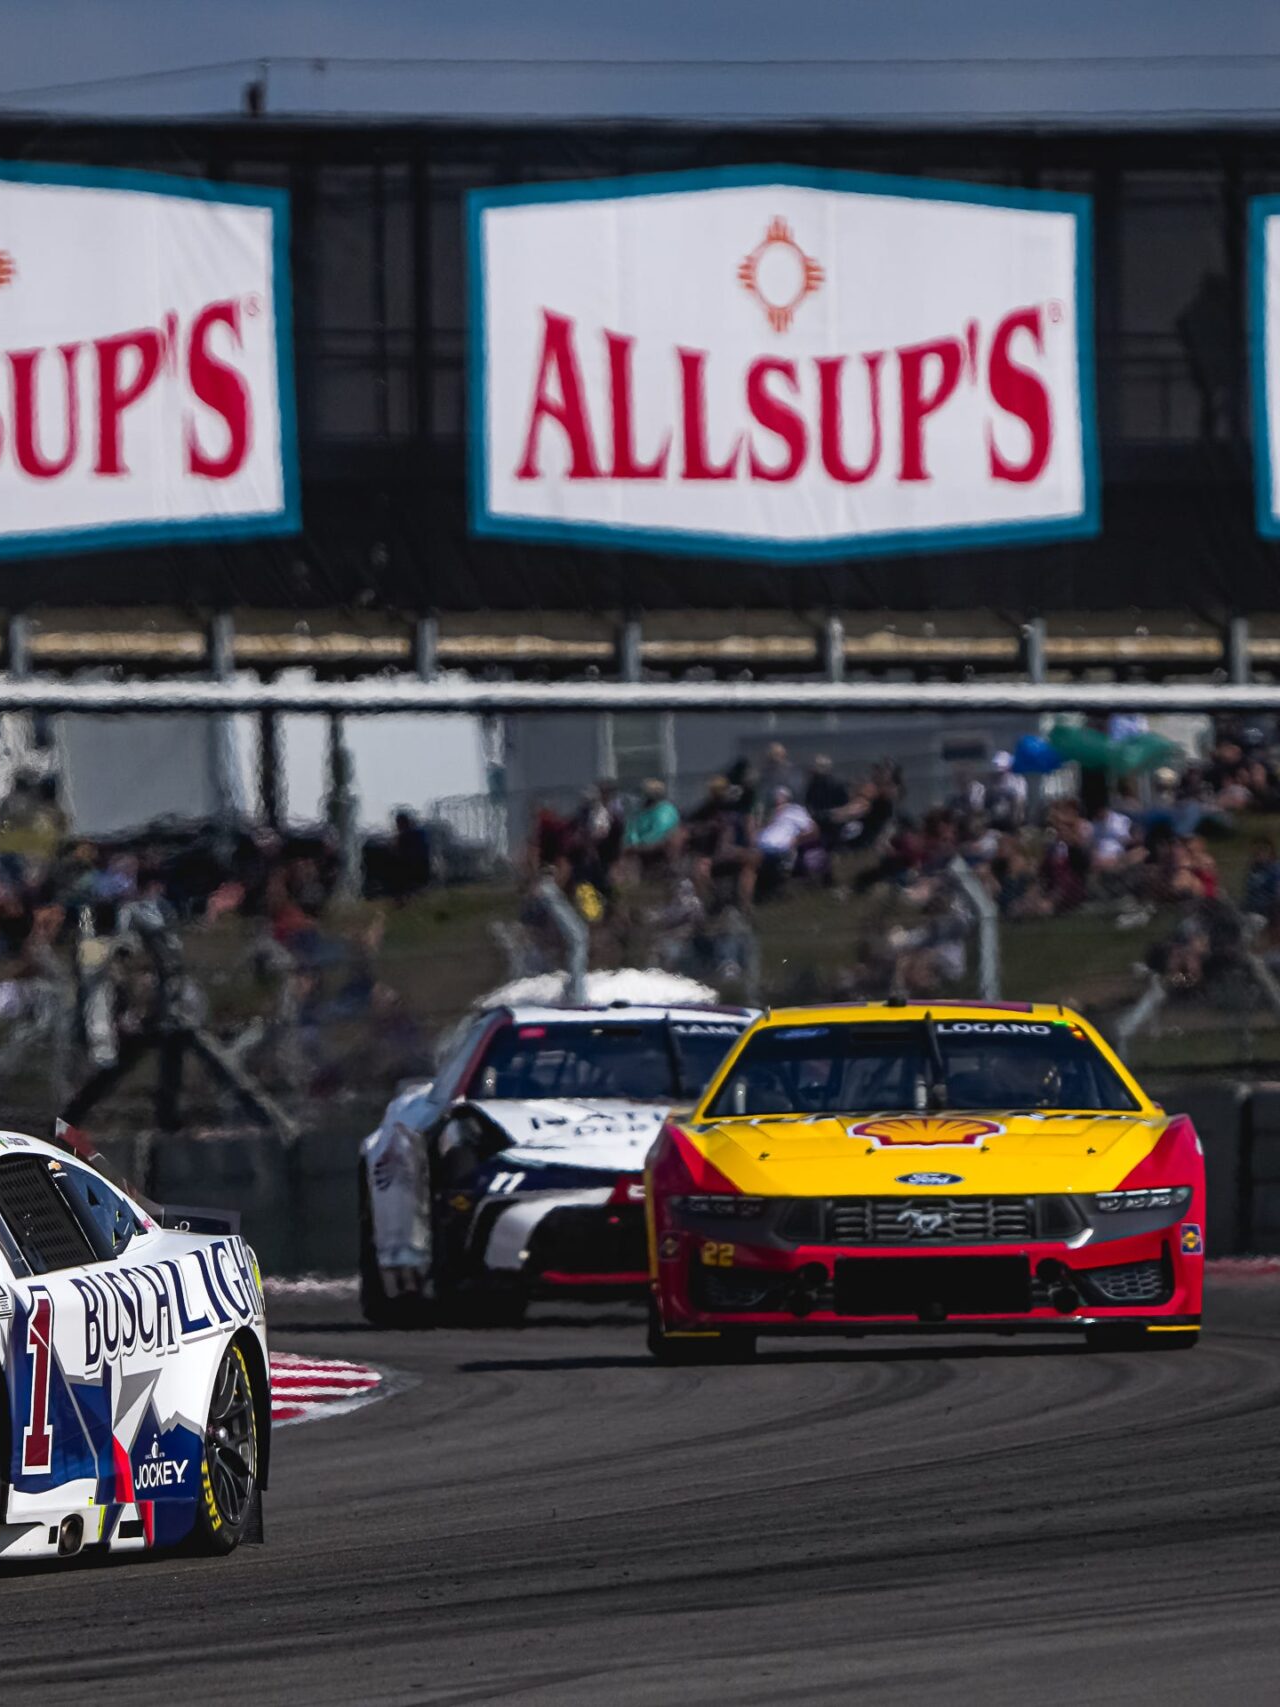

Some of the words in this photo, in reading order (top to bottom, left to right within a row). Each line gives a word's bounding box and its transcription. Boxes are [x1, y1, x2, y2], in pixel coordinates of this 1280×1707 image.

[516, 302, 1052, 484] ALLSUP'S
[936, 1023, 1051, 1035] LOGANO
[702, 1241, 736, 1267] 22
[69, 1260, 175, 1366] BUSCH
[22, 1285, 54, 1475] 1
[134, 1459, 189, 1490] JOCKEY
